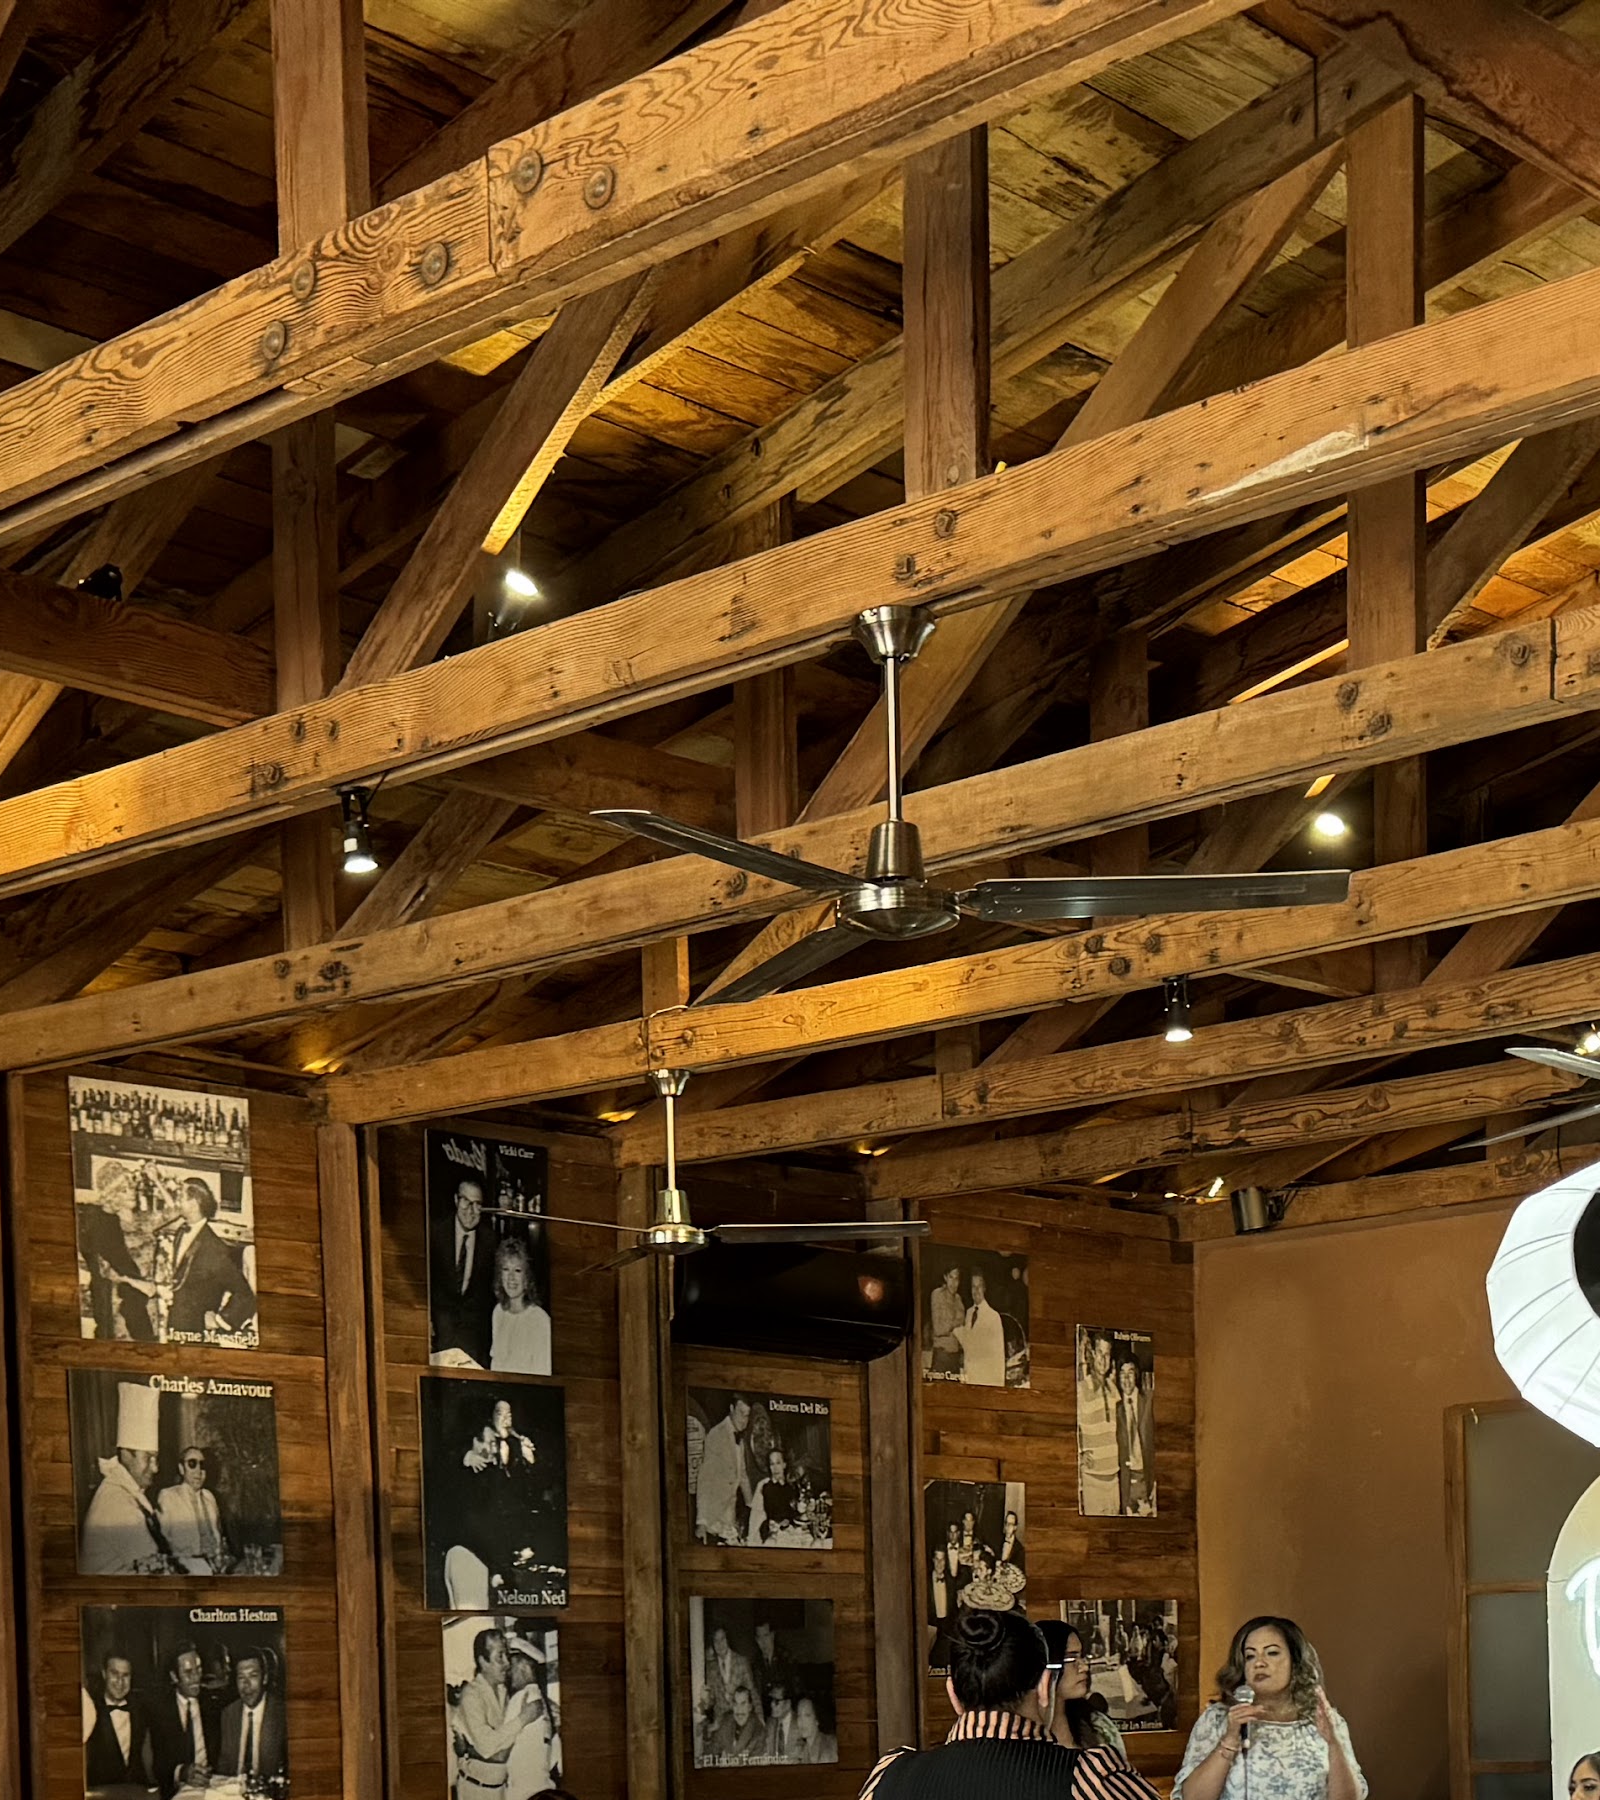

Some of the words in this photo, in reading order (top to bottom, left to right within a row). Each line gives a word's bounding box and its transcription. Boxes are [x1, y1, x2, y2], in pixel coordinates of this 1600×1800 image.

[166, 1327, 202, 1344] Jayne
[203, 1329, 260, 1347] Mansfield
[149, 1374, 205, 1394] Charles
[206, 1378, 274, 1398] Aznavour
[800, 1402, 814, 1414] Del
[497, 1588, 539, 1605] Nelson
[541, 1589, 567, 1605] Ned
[189, 1607, 237, 1623] Charlton
[239, 1608, 278, 1622] Heston
